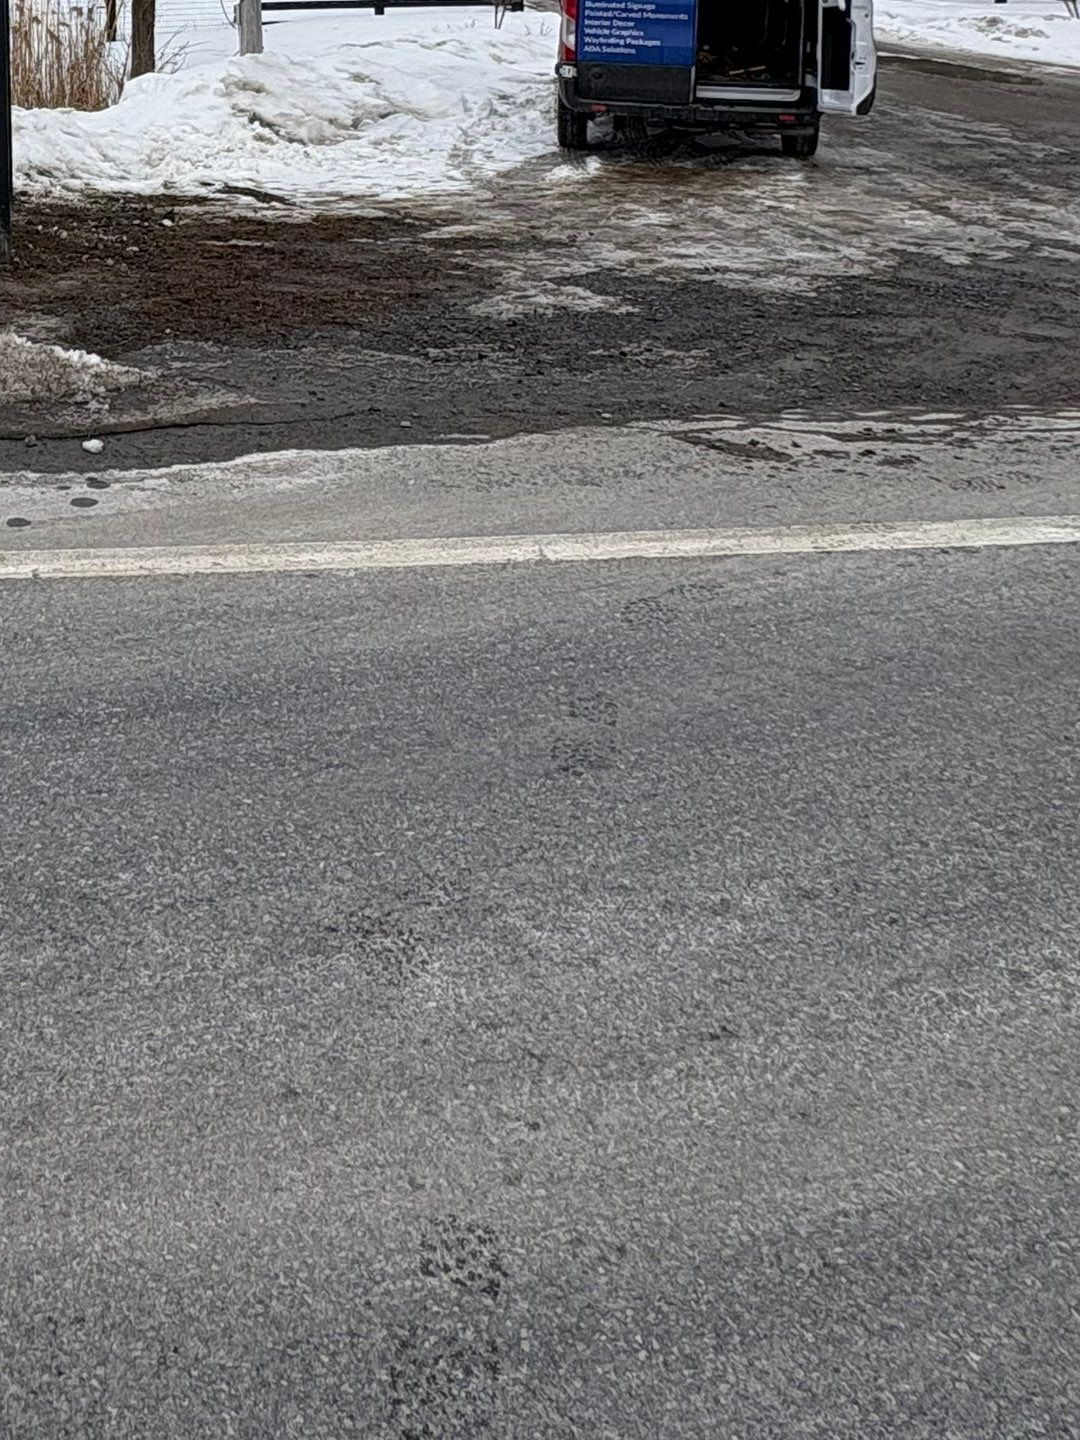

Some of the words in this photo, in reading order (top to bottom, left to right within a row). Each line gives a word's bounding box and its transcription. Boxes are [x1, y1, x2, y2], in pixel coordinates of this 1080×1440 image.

[585, 1, 625, 9] Illuminated
[627, 2, 656, 10] Signage
[612, 29, 644, 37] Graphics
[584, 37, 624, 45] Wayfinding
